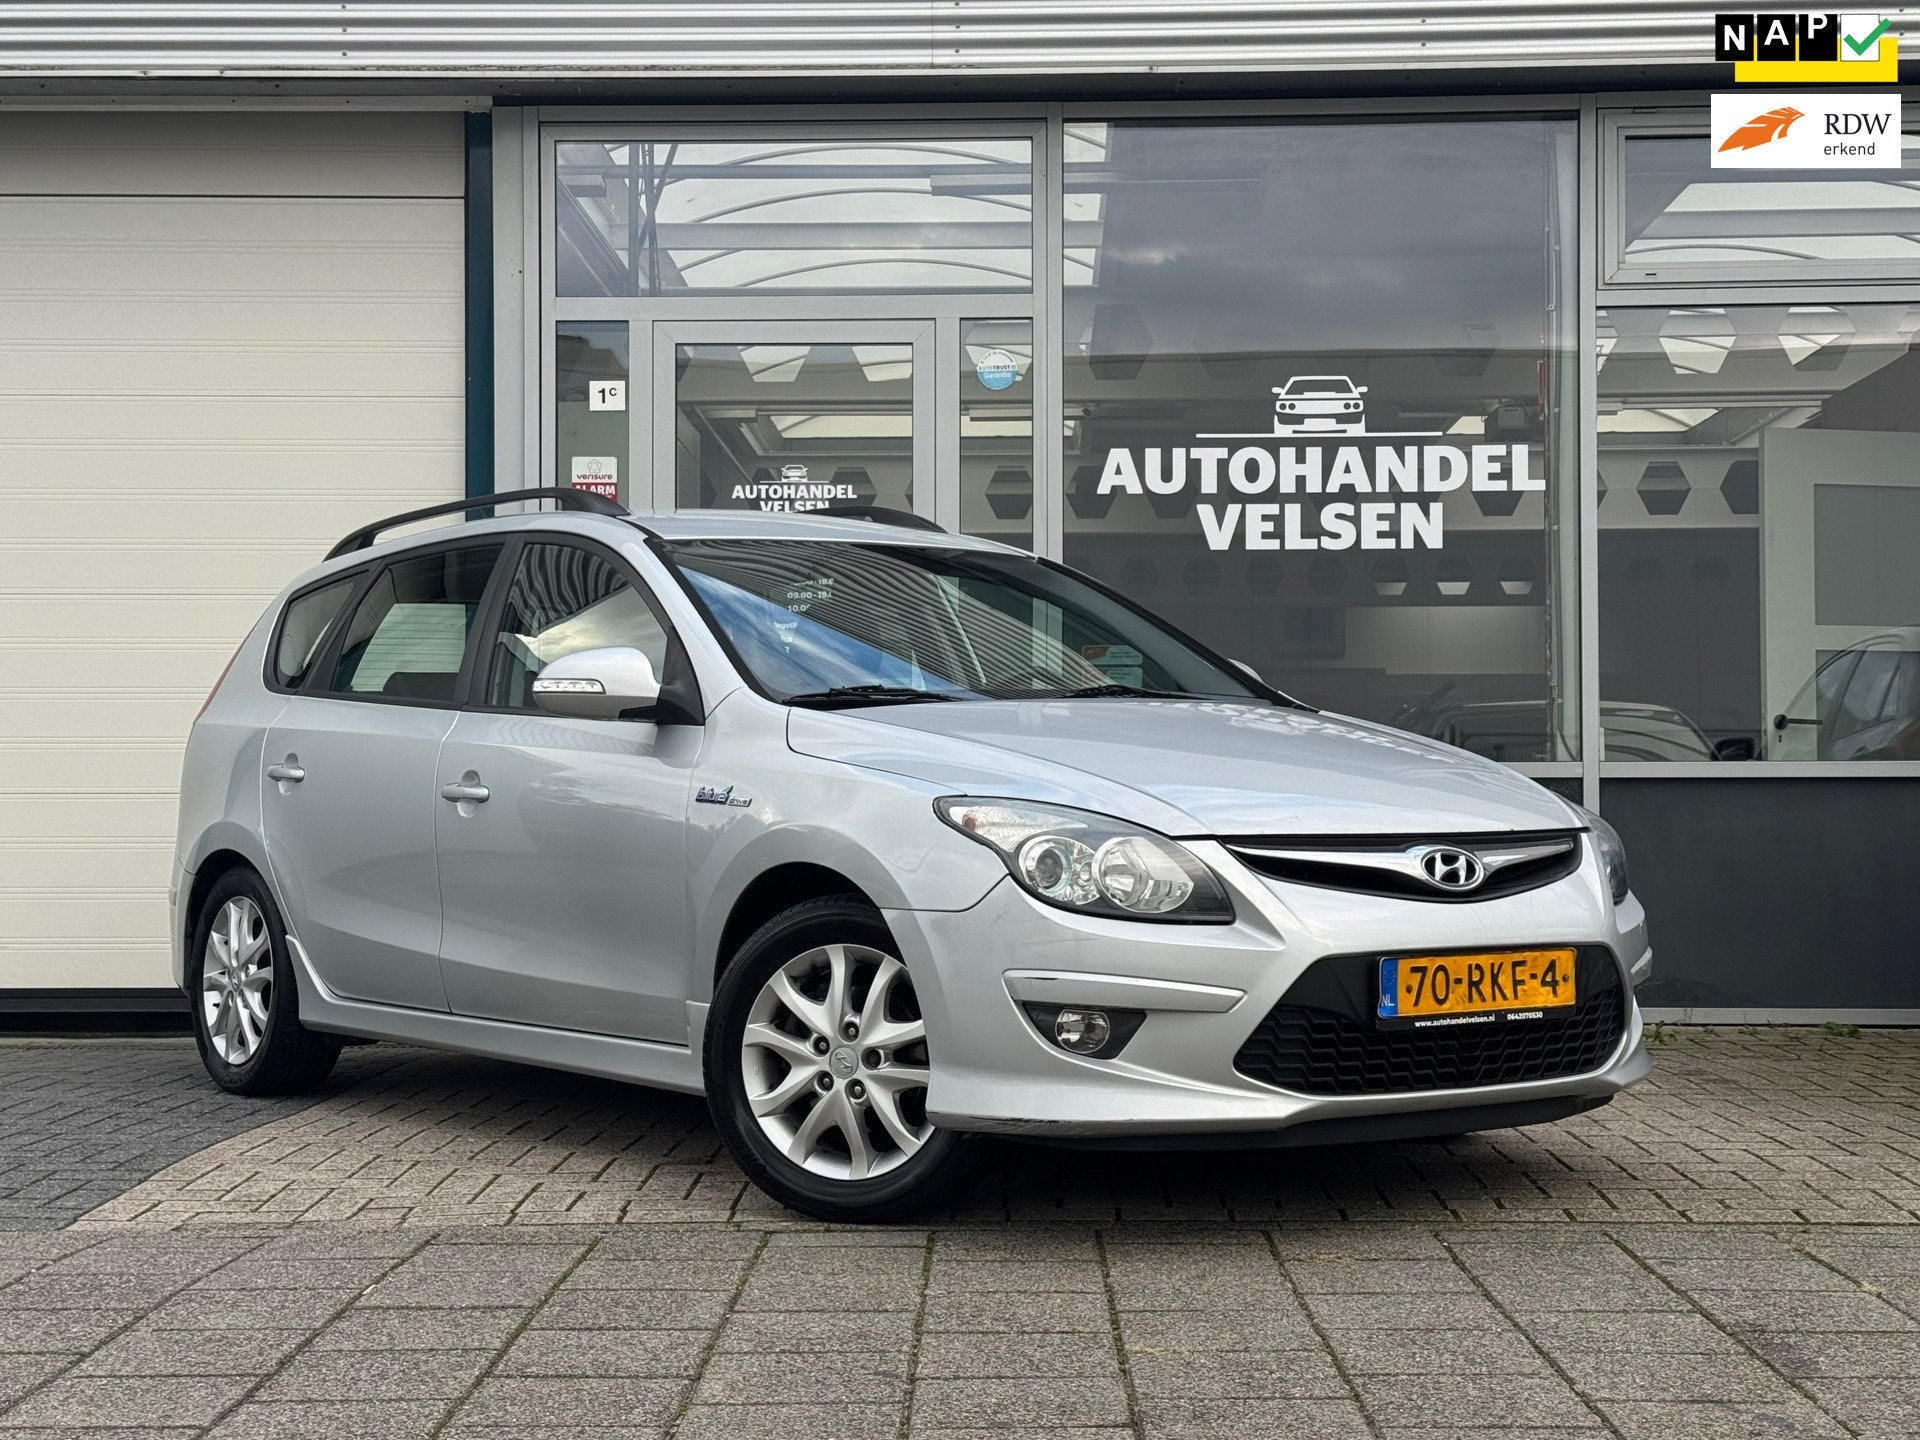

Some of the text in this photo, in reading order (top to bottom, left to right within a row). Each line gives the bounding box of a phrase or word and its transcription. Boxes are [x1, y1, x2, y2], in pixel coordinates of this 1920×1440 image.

[1096, 444, 1546, 494] AUTOHANDEL
[731, 484, 858, 499] AUTOHANDEL
[1196, 502, 1443, 551] VELSEN
[695, 786, 729, 805] blue
[1409, 958, 1560, 1008] 70-RKF-4
[1381, 994, 1395, 1007] NL
